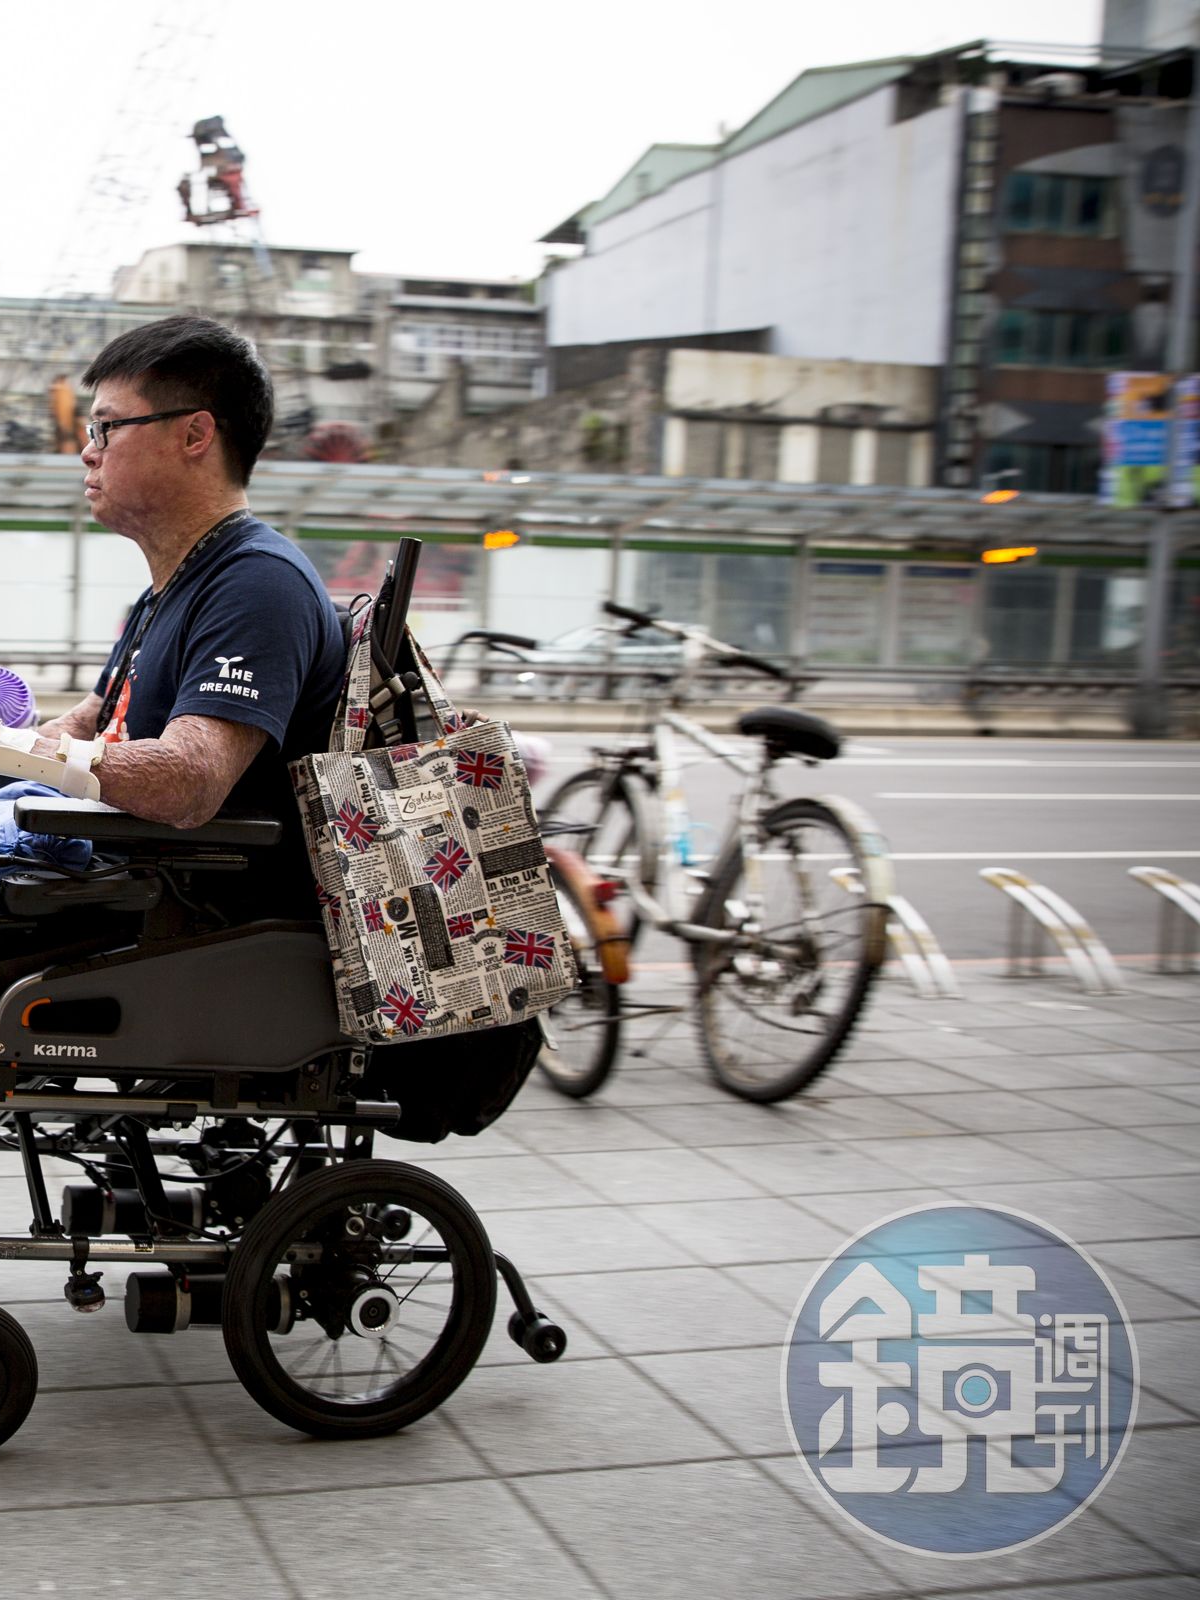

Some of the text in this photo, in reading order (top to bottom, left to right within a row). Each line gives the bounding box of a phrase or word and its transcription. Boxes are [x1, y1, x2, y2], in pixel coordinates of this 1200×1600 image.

[214, 656, 254, 682] THE
[199, 682, 259, 700] DREAMER
[352, 764, 366, 780] UK
[360, 783, 373, 803] the
[366, 806, 377, 819] In
[485, 868, 540, 891] In the UK
[402, 945, 425, 1002] In the UK
